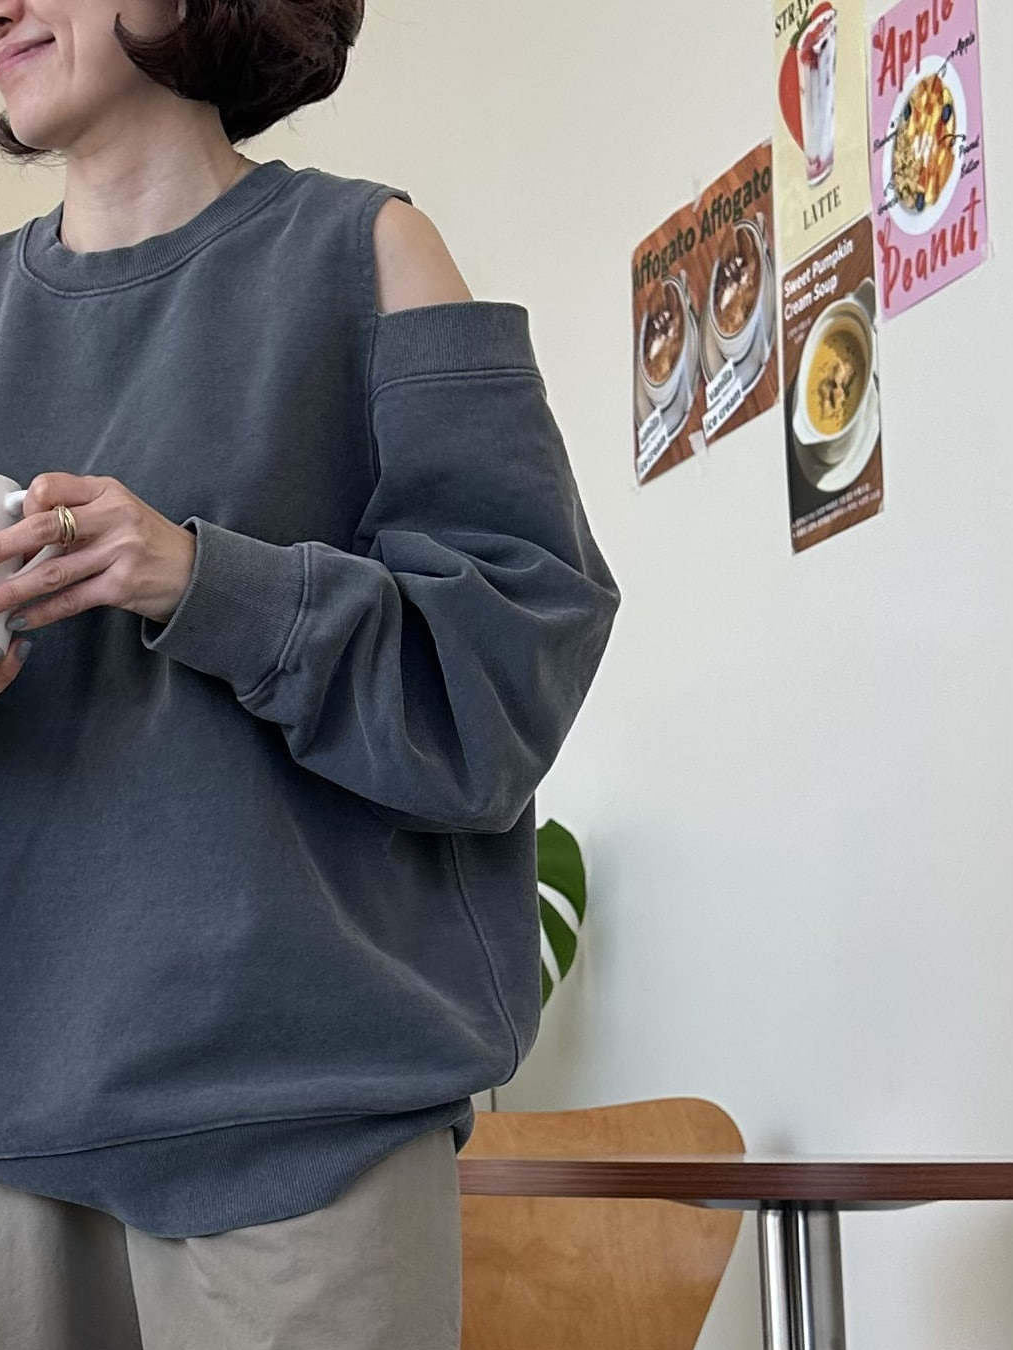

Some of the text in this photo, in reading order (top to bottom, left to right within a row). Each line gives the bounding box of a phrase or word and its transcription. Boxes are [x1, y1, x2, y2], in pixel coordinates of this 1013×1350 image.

[873, 0, 954, 96] Apple
[700, 166, 772, 243] Affogato
[802, 185, 842, 230] LATTE
[784, 238, 854, 298] Sweet Pumpkin
[876, 187, 981, 309] Peanut
[784, 274, 838, 320] Cream Soup
